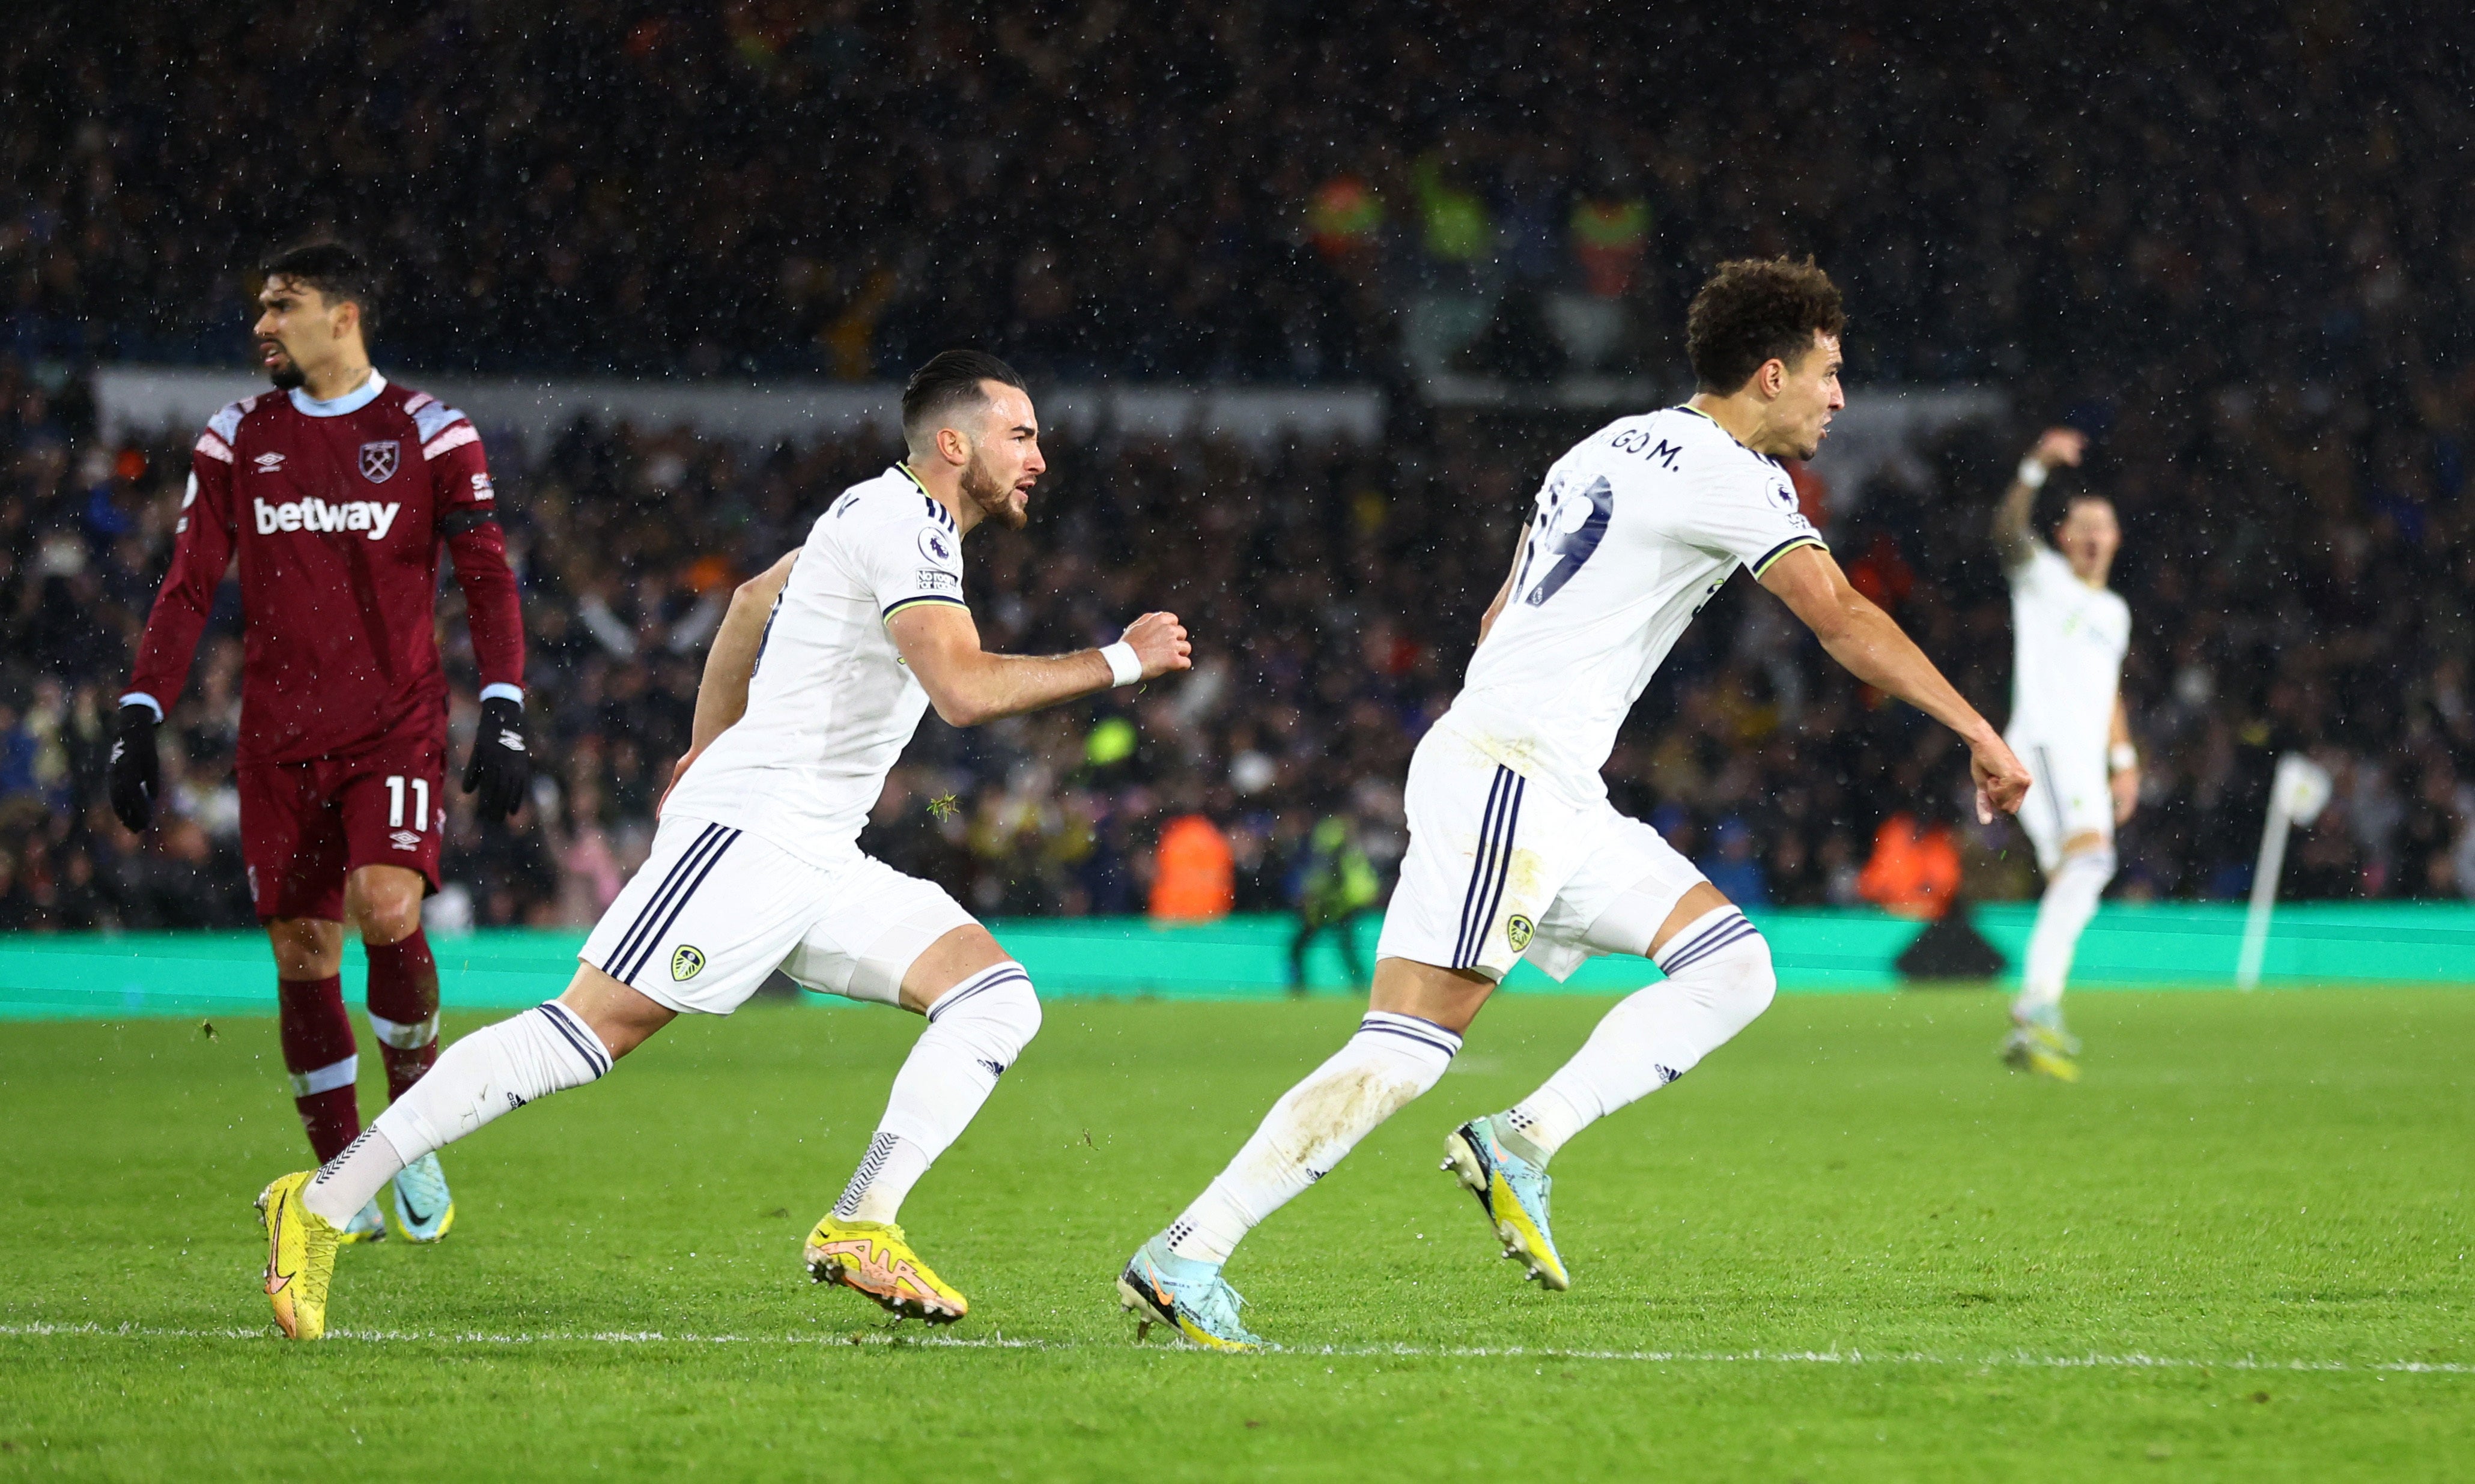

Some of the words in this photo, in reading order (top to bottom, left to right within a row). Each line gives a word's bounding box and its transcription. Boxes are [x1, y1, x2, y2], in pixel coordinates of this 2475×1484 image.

[1644, 438, 1684, 473] M.
[254, 495, 401, 541] betway
[916, 571, 933, 581] No
[385, 775, 430, 833] 11
